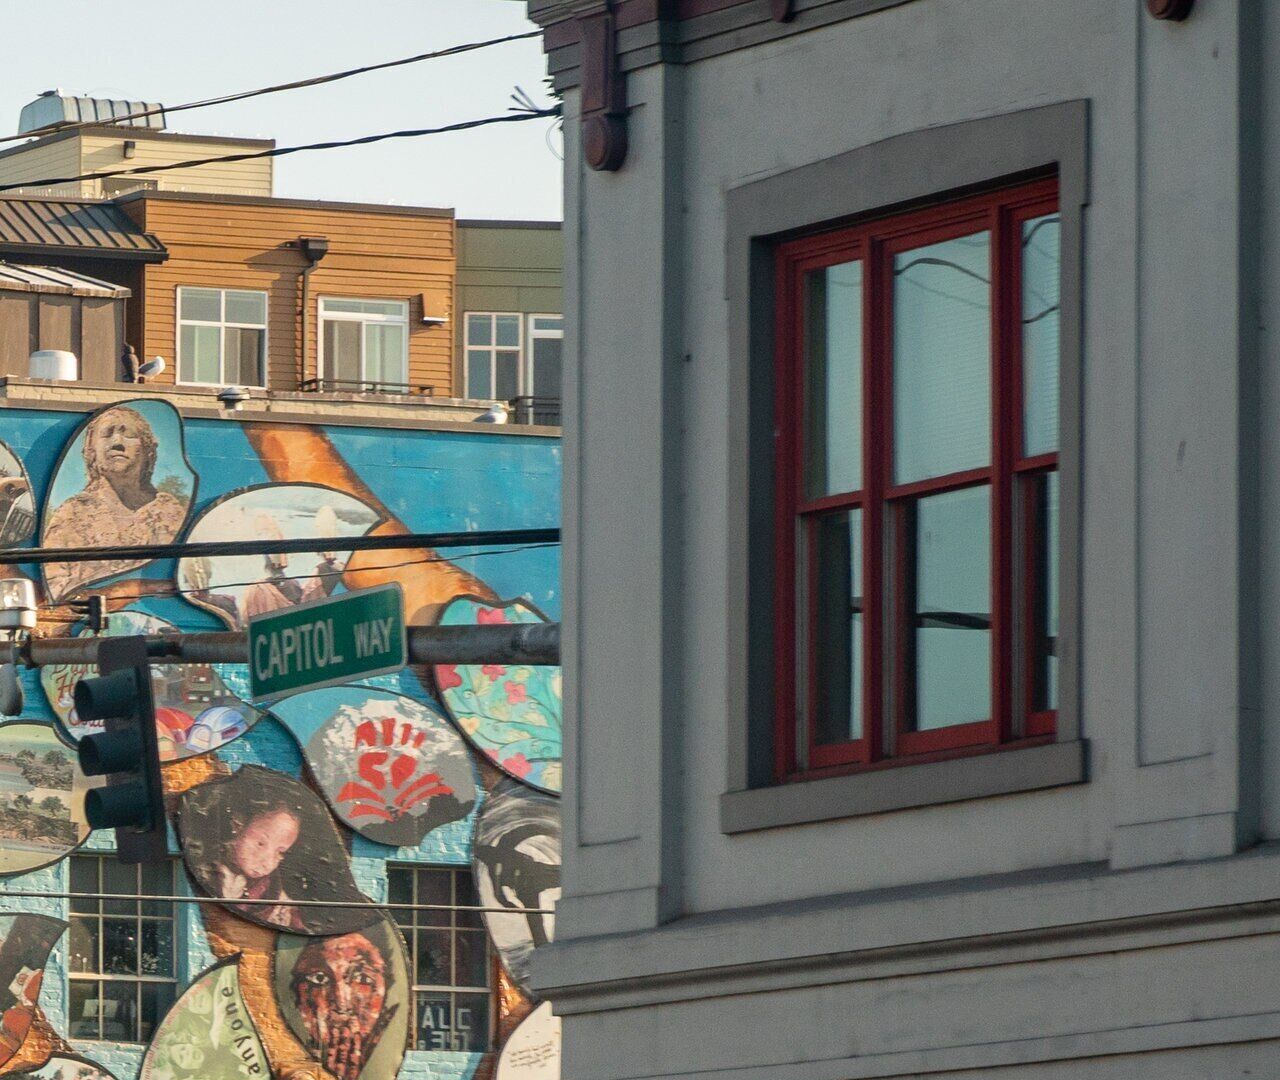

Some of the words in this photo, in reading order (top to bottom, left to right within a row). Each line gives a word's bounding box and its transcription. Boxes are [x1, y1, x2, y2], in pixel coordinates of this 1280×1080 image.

[255, 619, 344, 681] CAPITOL
[354, 617, 394, 659] WAY
[222, 986, 261, 1075] anyone
